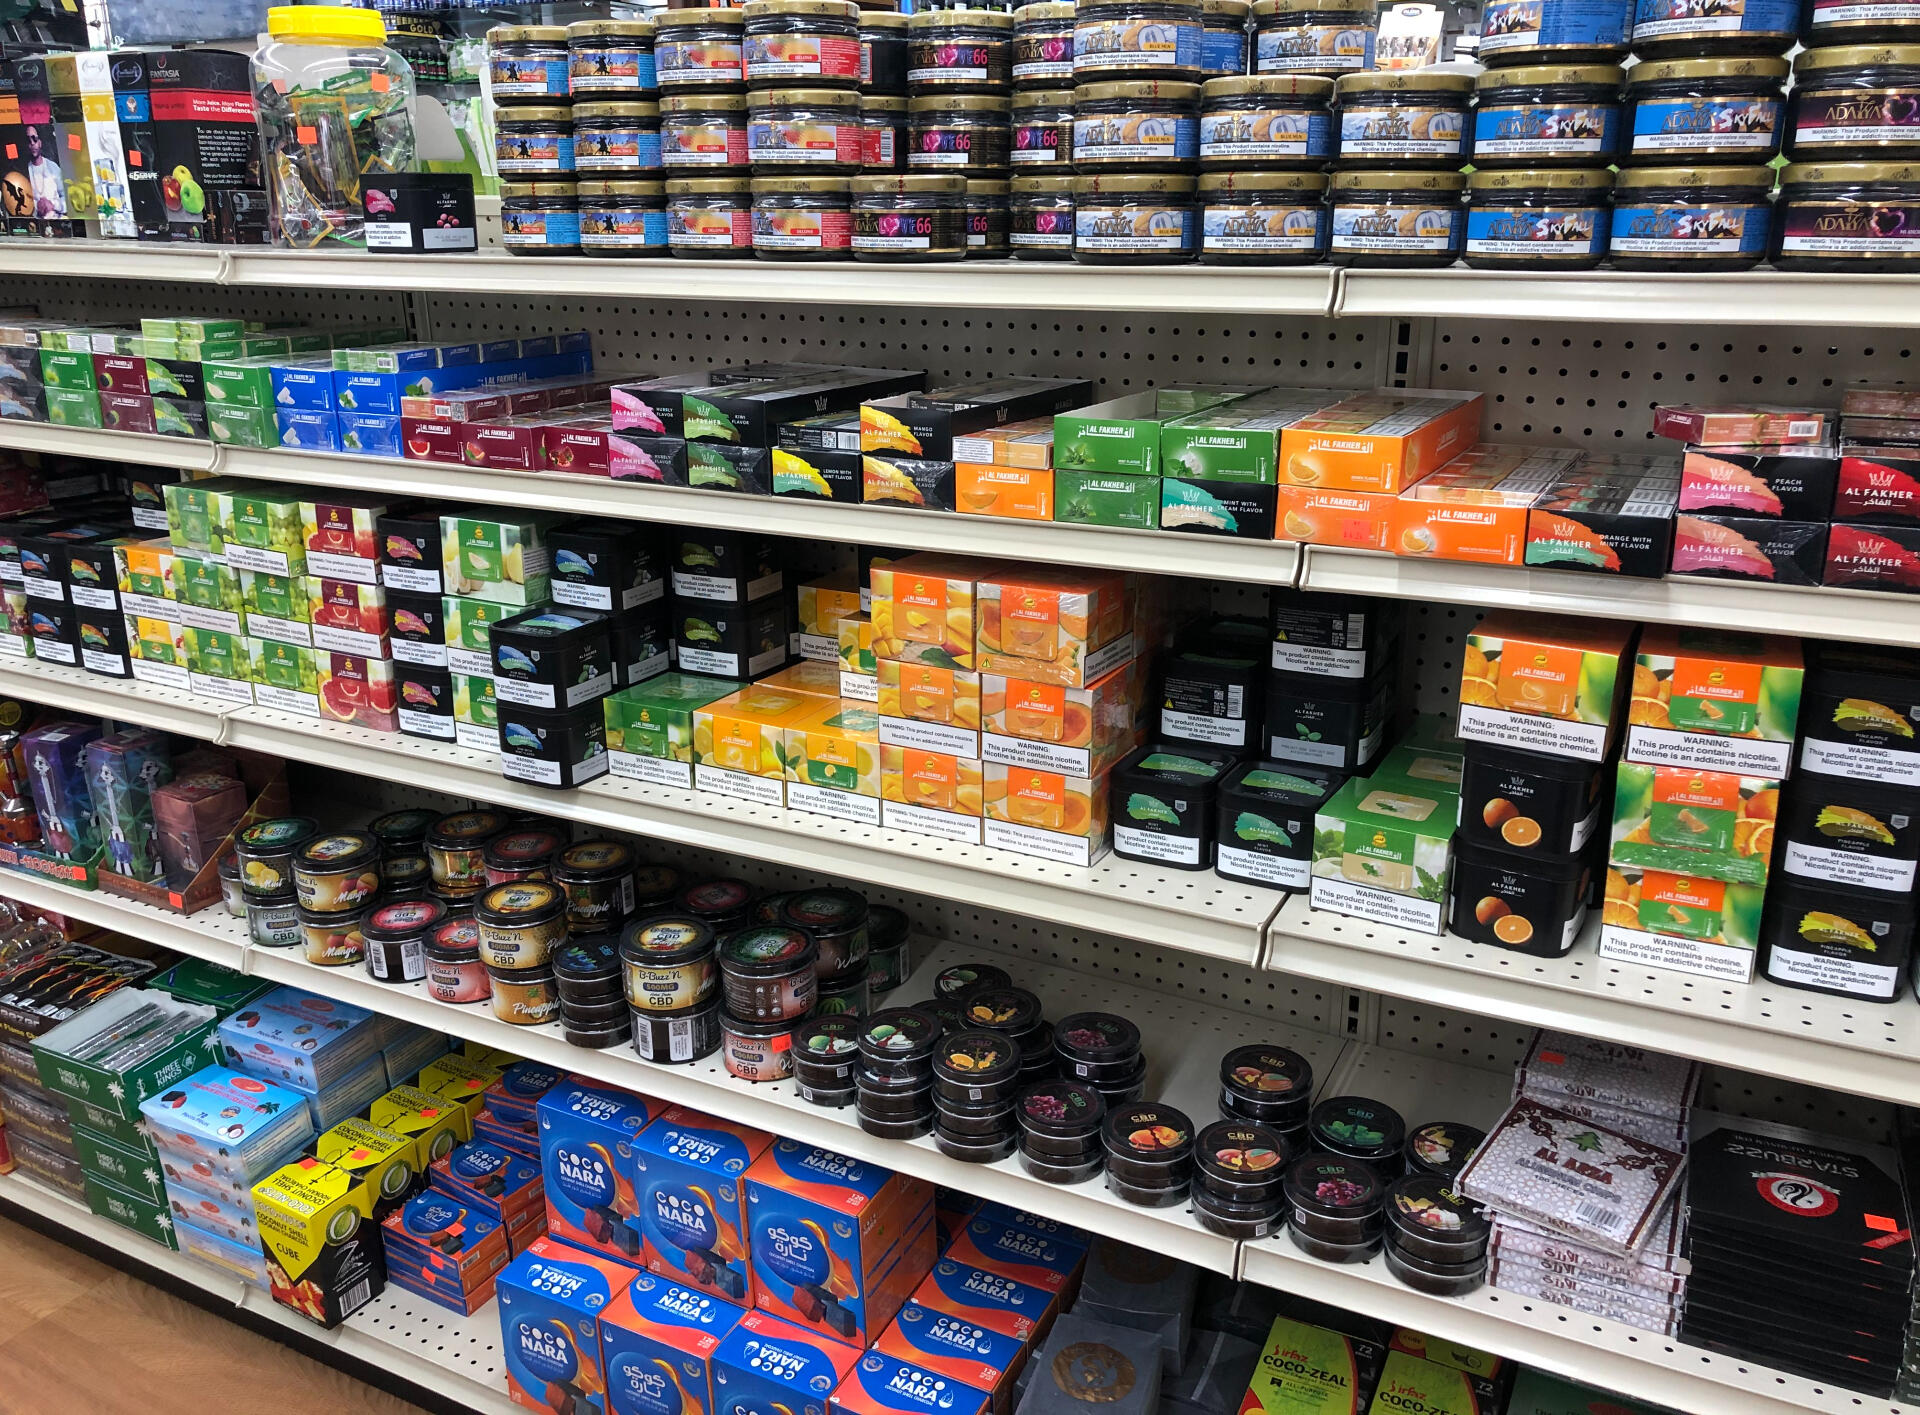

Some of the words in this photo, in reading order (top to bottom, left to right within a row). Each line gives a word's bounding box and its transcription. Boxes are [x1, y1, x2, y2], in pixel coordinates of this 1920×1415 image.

[1089, 426, 1098, 434] AL
[1099, 426, 1124, 436] FAKHER
[1199, 436, 1208, 444] AL
[1209, 437, 1235, 446] FAKHER
[1322, 440, 1331, 448] AL
[1332, 441, 1361, 450] FAKHER
[1688, 482, 1703, 490] AL
[1705, 483, 1752, 493] FAKHER
[1845, 488, 1861, 496] AL
[1864, 489, 1913, 499] FAKHER
[1180, 504, 1213, 512] FAKHER
[1441, 510, 1452, 519] AL
[1453, 511, 1483, 521] FAKHER
[1534, 537, 1547, 546] AL
[1550, 538, 1591, 549] FAKHER
[1599, 534, 1630, 543] ORANGE
[1599, 540, 1618, 548] MINT
[1621, 541, 1650, 549] FLAVOR
[1834, 555, 1849, 563] AL
[1853, 556, 1902, 567] FAKHER
[1510, 716, 1555, 729] WARNING:
[1468, 718, 1485, 726] This
[1487, 721, 1520, 732] product
[1521, 727, 1558, 738] contains
[1560, 734, 1596, 744] nicotine.
[1017, 742, 1050, 752] WARNING:
[1462, 726, 1496, 737] Nicotine
[1519, 735, 1558, 747] addictive
[1559, 742, 1600, 754] chemical.
[1683, 736, 1733, 748] WARNING:
[1002, 747, 1026, 755] product
[1027, 752, 1053, 760] contains
[1055, 757, 1082, 765] nicotine.
[1638, 739, 1657, 748] This
[1659, 743, 1694, 753] product
[1696, 748, 1736, 757] contains
[1738, 752, 1778, 763] nicotine.
[984, 750, 1009, 759] Nicotine
[1026, 758, 1054, 767] addictive
[1056, 764, 1086, 773] chemical.
[1631, 747, 1668, 759] Nicotine
[1694, 756, 1736, 766] addictive
[1738, 761, 1783, 772] chemical.
[1511, 783, 1535, 794] FAKHER
[333, 888, 368, 904] Mango
[1319, 889, 1335, 898] This
[1336, 892, 1364, 904] product
[1366, 900, 1398, 912] contains
[1400, 907, 1432, 919] nicotine.
[1356, 889, 1396, 903] WARNING:
[566, 899, 609, 918] Pineapple
[1314, 896, 1344, 907] Nicotine
[1365, 908, 1398, 919] addictive
[1400, 915, 1436, 928] chemical.
[272, 932, 295, 940] CBD
[322, 947, 357, 958] Mango
[493, 955, 515, 965] CBD
[437, 988, 456, 997] CBD
[649, 996, 673, 1005] CBD
[154, 1058, 180, 1079] THREE
[736, 1063, 758, 1074] CBD
[1259, 1055, 1286, 1068] CBD
[157, 1068, 182, 1087] KINGS
[1070, 1092, 1087, 1108] CBD
[333, 1130, 359, 1144] HOOKAH
[358, 1139, 385, 1154] CHARCOAL
[338, 1126, 372, 1142] COCONUT
[374, 1139, 393, 1150] SHELL
[1227, 1132, 1255, 1140] CBD
[465, 1155, 494, 1171] NARA
[474, 1150, 501, 1167] COCO
[556, 1148, 604, 1174] COCO
[1534, 1147, 1559, 1164] AL
[1725, 1143, 1859, 1178] STARBUZZ
[558, 1163, 606, 1190] NARA
[1316, 1165, 1346, 1174] CBD
[272, 1178, 292, 1193] SHELL
[294, 1190, 325, 1205] COCONUT
[654, 1190, 705, 1216] COCO
[850, 1192, 865, 1201] 120
[257, 1211, 287, 1231] COCONUT
[289, 1227, 308, 1242] SHELL
[656, 1204, 708, 1234] NARA
[276, 1243, 300, 1261] CUBE
[971, 1271, 1017, 1290] COCO
[964, 1277, 1011, 1301] NARA
[518, 1322, 567, 1350] COCO
[936, 1318, 984, 1339] COCO
[929, 1325, 977, 1350] NARA
[520, 1336, 569, 1365] NARA
[1359, 1345, 1373, 1354] 72
[897, 1367, 946, 1391] COCO
[983, 1367, 997, 1377] 120
[1263, 1355, 1348, 1387] COCO-ZEAL
[889, 1375, 939, 1402] NARA
